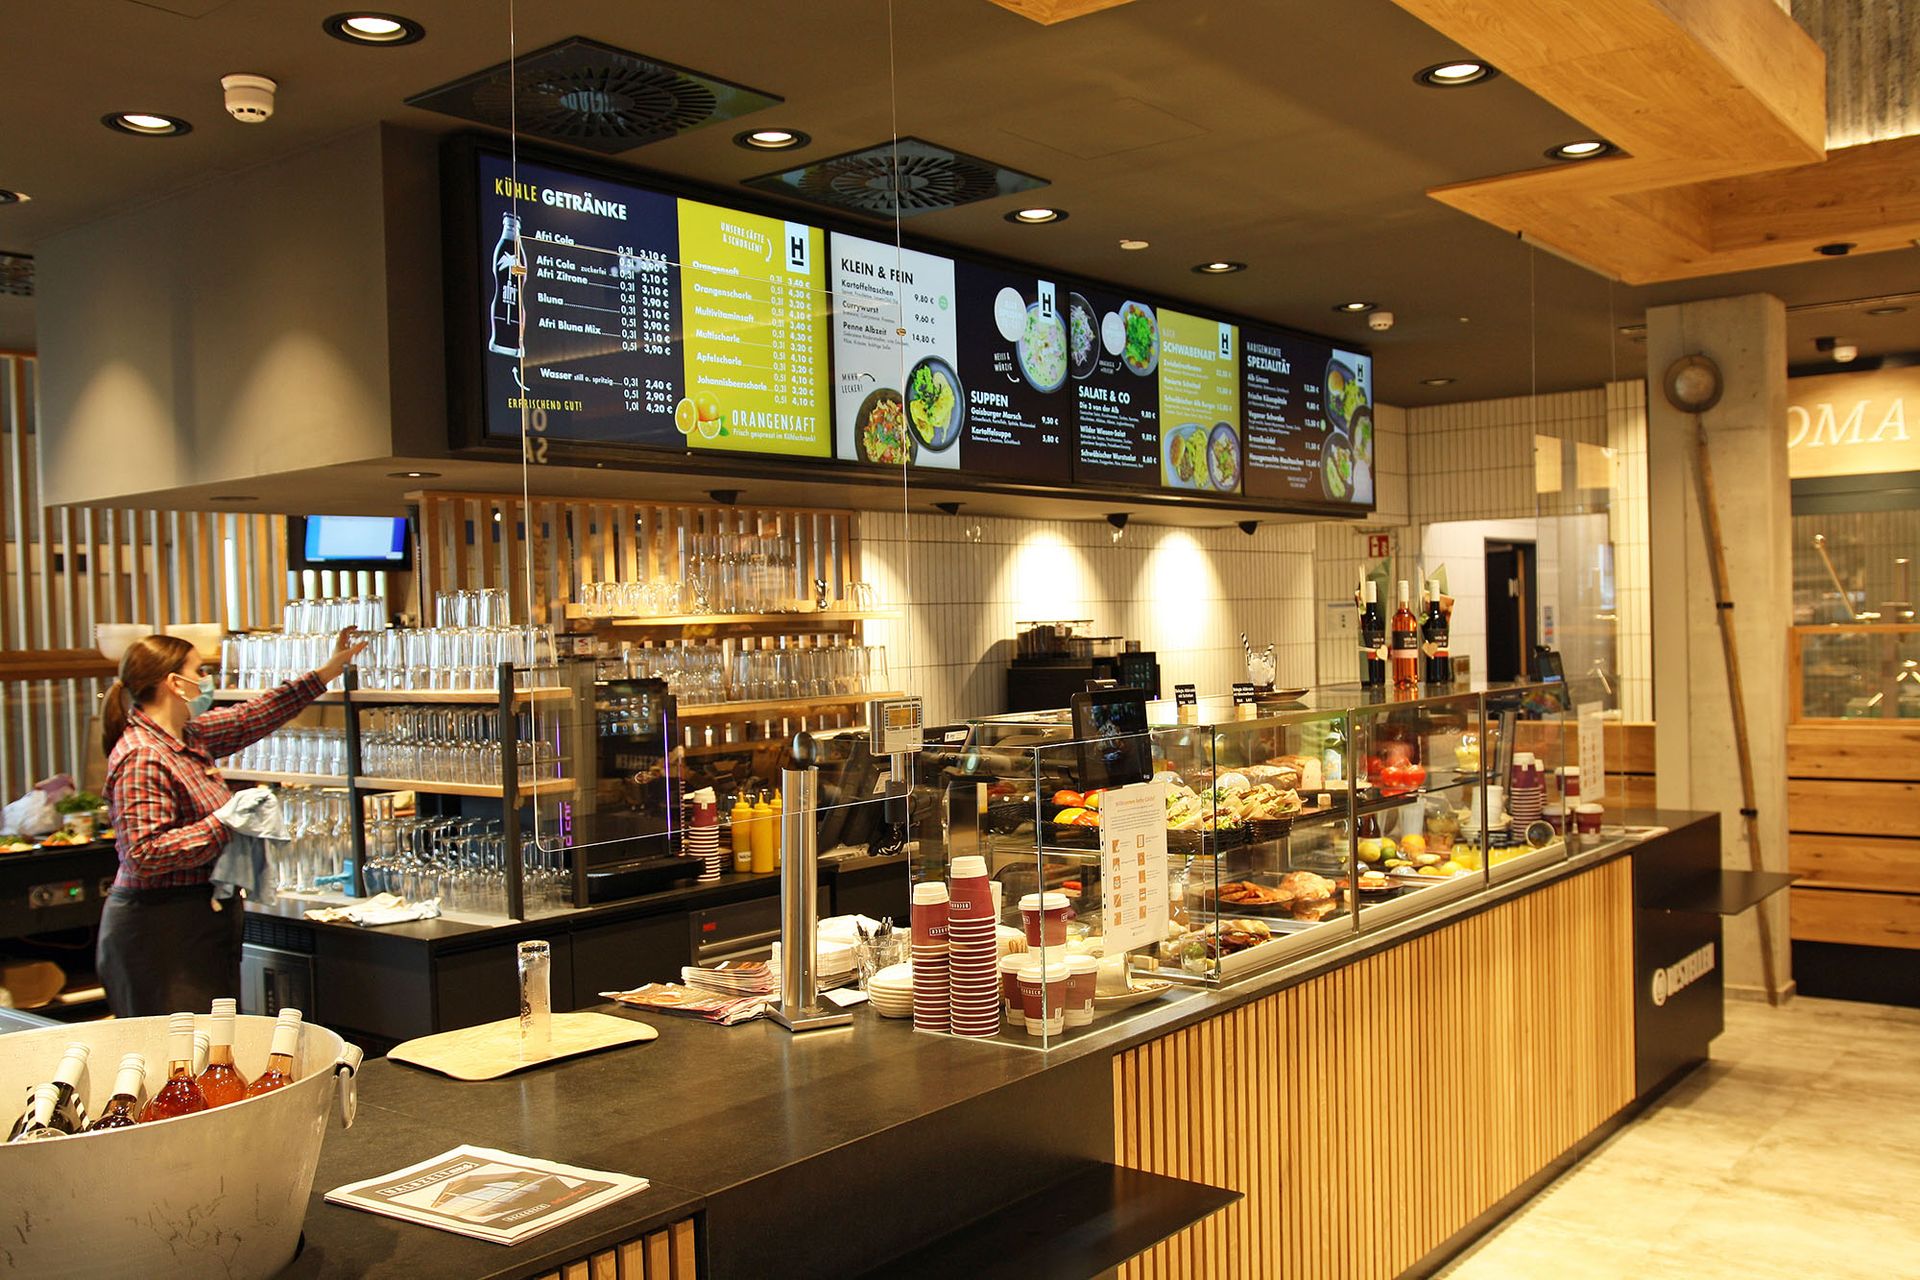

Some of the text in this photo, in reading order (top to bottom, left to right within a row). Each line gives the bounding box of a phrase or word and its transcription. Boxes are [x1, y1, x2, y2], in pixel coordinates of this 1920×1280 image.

[495, 176, 627, 220] KÜHLE GETRÄNKE
[720, 221, 764, 244] UNSERE SÄFTE
[535, 230, 667, 261] Afri Cola 0,3l 3,10 €
[536, 255, 553, 266] Afri
[555, 258, 575, 271] Cola
[619, 270, 635, 279] 0,3l
[641, 273, 660, 284] 3,10
[662, 277, 668, 286] €
[618, 257, 668, 274] 0,5l 3,90 €
[692, 260, 739, 275] Orangensaft
[841, 258, 913, 285] KLEIN & FEIN
[536, 268, 669, 297] Afri Zitrone 0,3l 3,10 €
[694, 283, 752, 300] Orangenschorle
[842, 279, 894, 296] Kartoffeltaschen
[914, 294, 928, 304] 9,80
[538, 292, 670, 321] Bluna 0,3l 3,10 €
[620, 294, 669, 309] 0,5l 3,90 €
[1043, 293, 1051, 313] H
[695, 306, 754, 323] Multivitaminsaft
[842, 300, 879, 314] Currywurst
[914, 314, 929, 324] 9,60
[538, 318, 671, 344] Afri Bluna Mix 0,3l 3,10 €
[621, 317, 670, 332] 0,5l 3,90 €
[843, 321, 863, 332] Penne
[865, 325, 886, 335] Albzeit
[696, 329, 740, 343] Multischorle
[1222, 333, 1229, 350] H
[622, 341, 671, 356] 0,5l 3,90 €
[1163, 341, 1216, 361] SCHWABENART
[696, 352, 743, 367] Apfelschorle
[1247, 355, 1290, 374] SPEZIALITÄT
[540, 368, 572, 381] Wasser
[592, 376, 613, 386] spritzig
[623, 377, 638, 387] 0,3l
[645, 379, 664, 391] 2,40
[666, 382, 672, 391] €
[697, 375, 767, 391] Johannisbeerschorle
[792, 386, 807, 396] 3,20
[623, 389, 672, 402] 0,5l 2,90 €
[792, 397, 808, 406] 4,10
[971, 391, 1008, 407] SUPPEN
[1079, 385, 1130, 404] SALATE & CO
[508, 398, 582, 412] ERFRISCHEND GUT!
[625, 401, 673, 414] 1,0l 4,20 €
[1079, 401, 1087, 409] Die
[732, 410, 815, 432] ORANGENSAFT
[971, 407, 1001, 419] Gaisburger
[1002, 411, 1022, 420] Marsch
[1055, 418, 1059, 426] €
[971, 426, 1011, 438] Kartoffelsuppe
